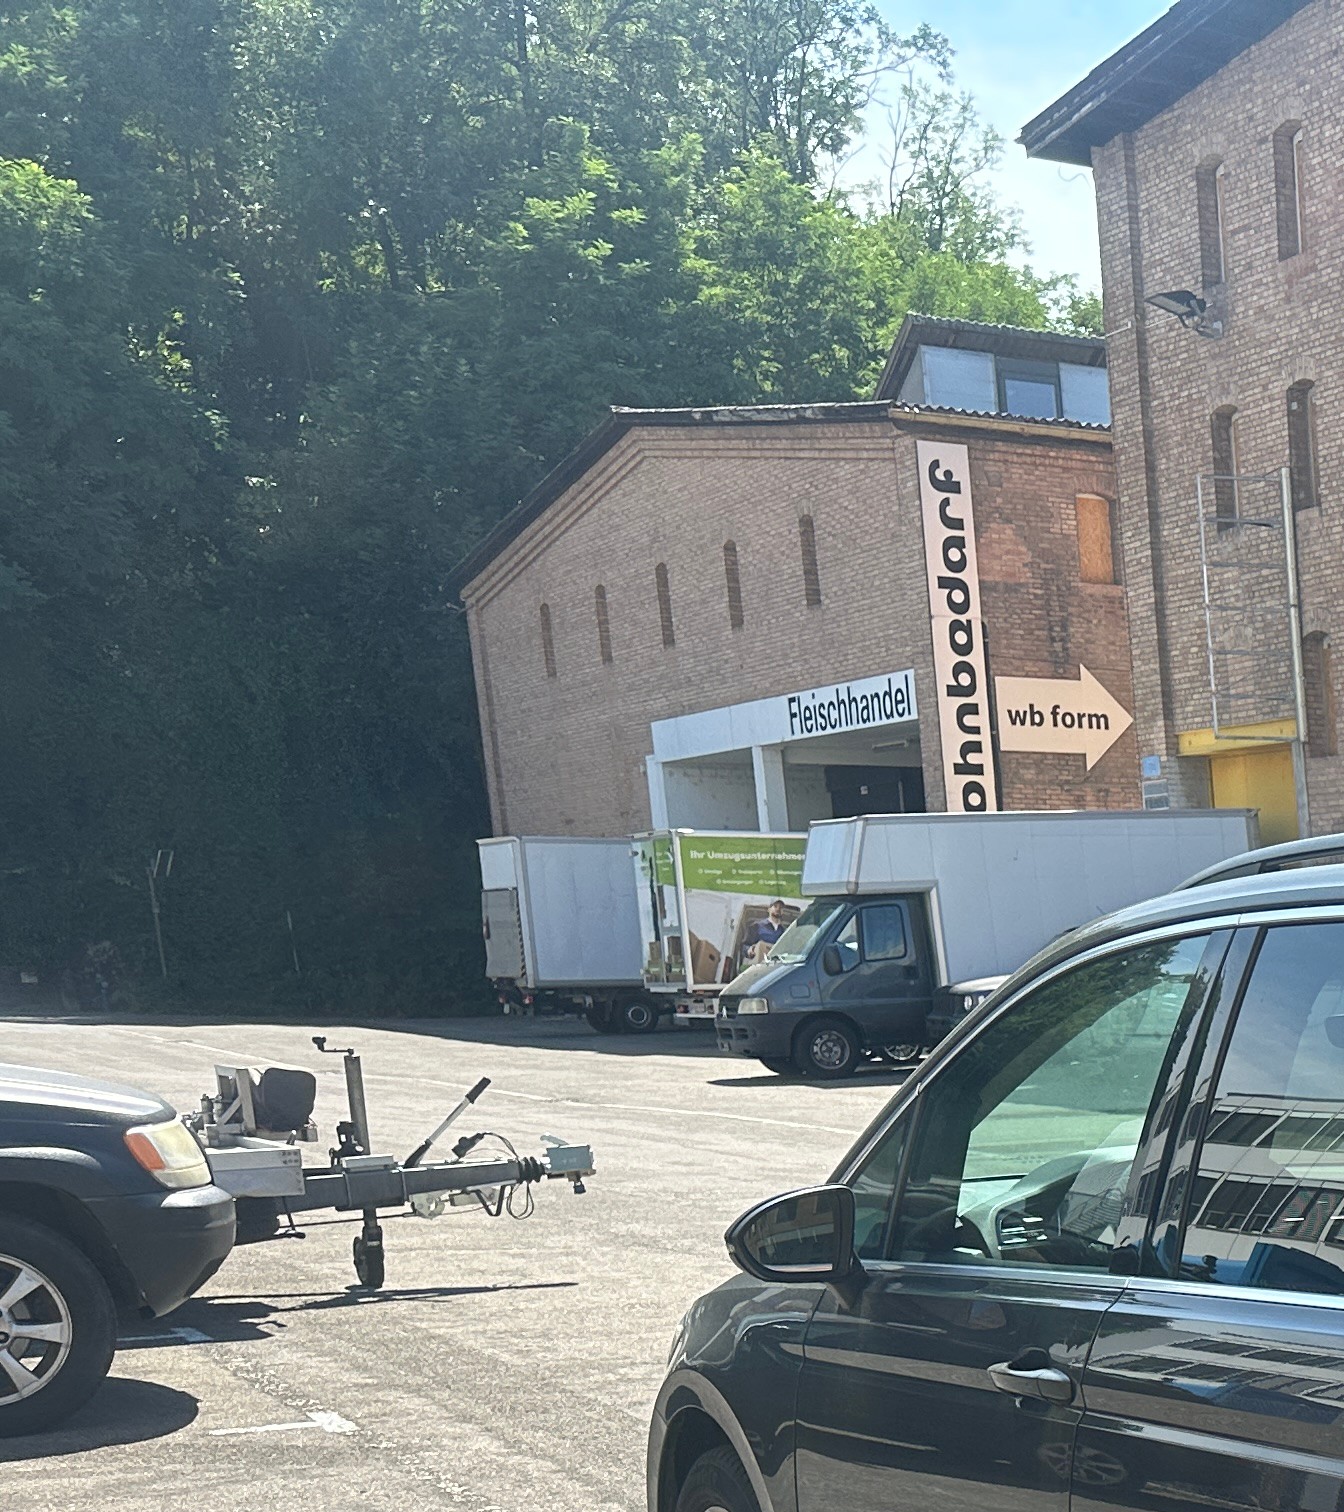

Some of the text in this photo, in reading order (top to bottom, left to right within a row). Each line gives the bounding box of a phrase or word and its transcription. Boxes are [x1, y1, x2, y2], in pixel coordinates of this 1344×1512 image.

[788, 673, 912, 736] Fleischhandel
[1007, 703, 1110, 731] wb form
